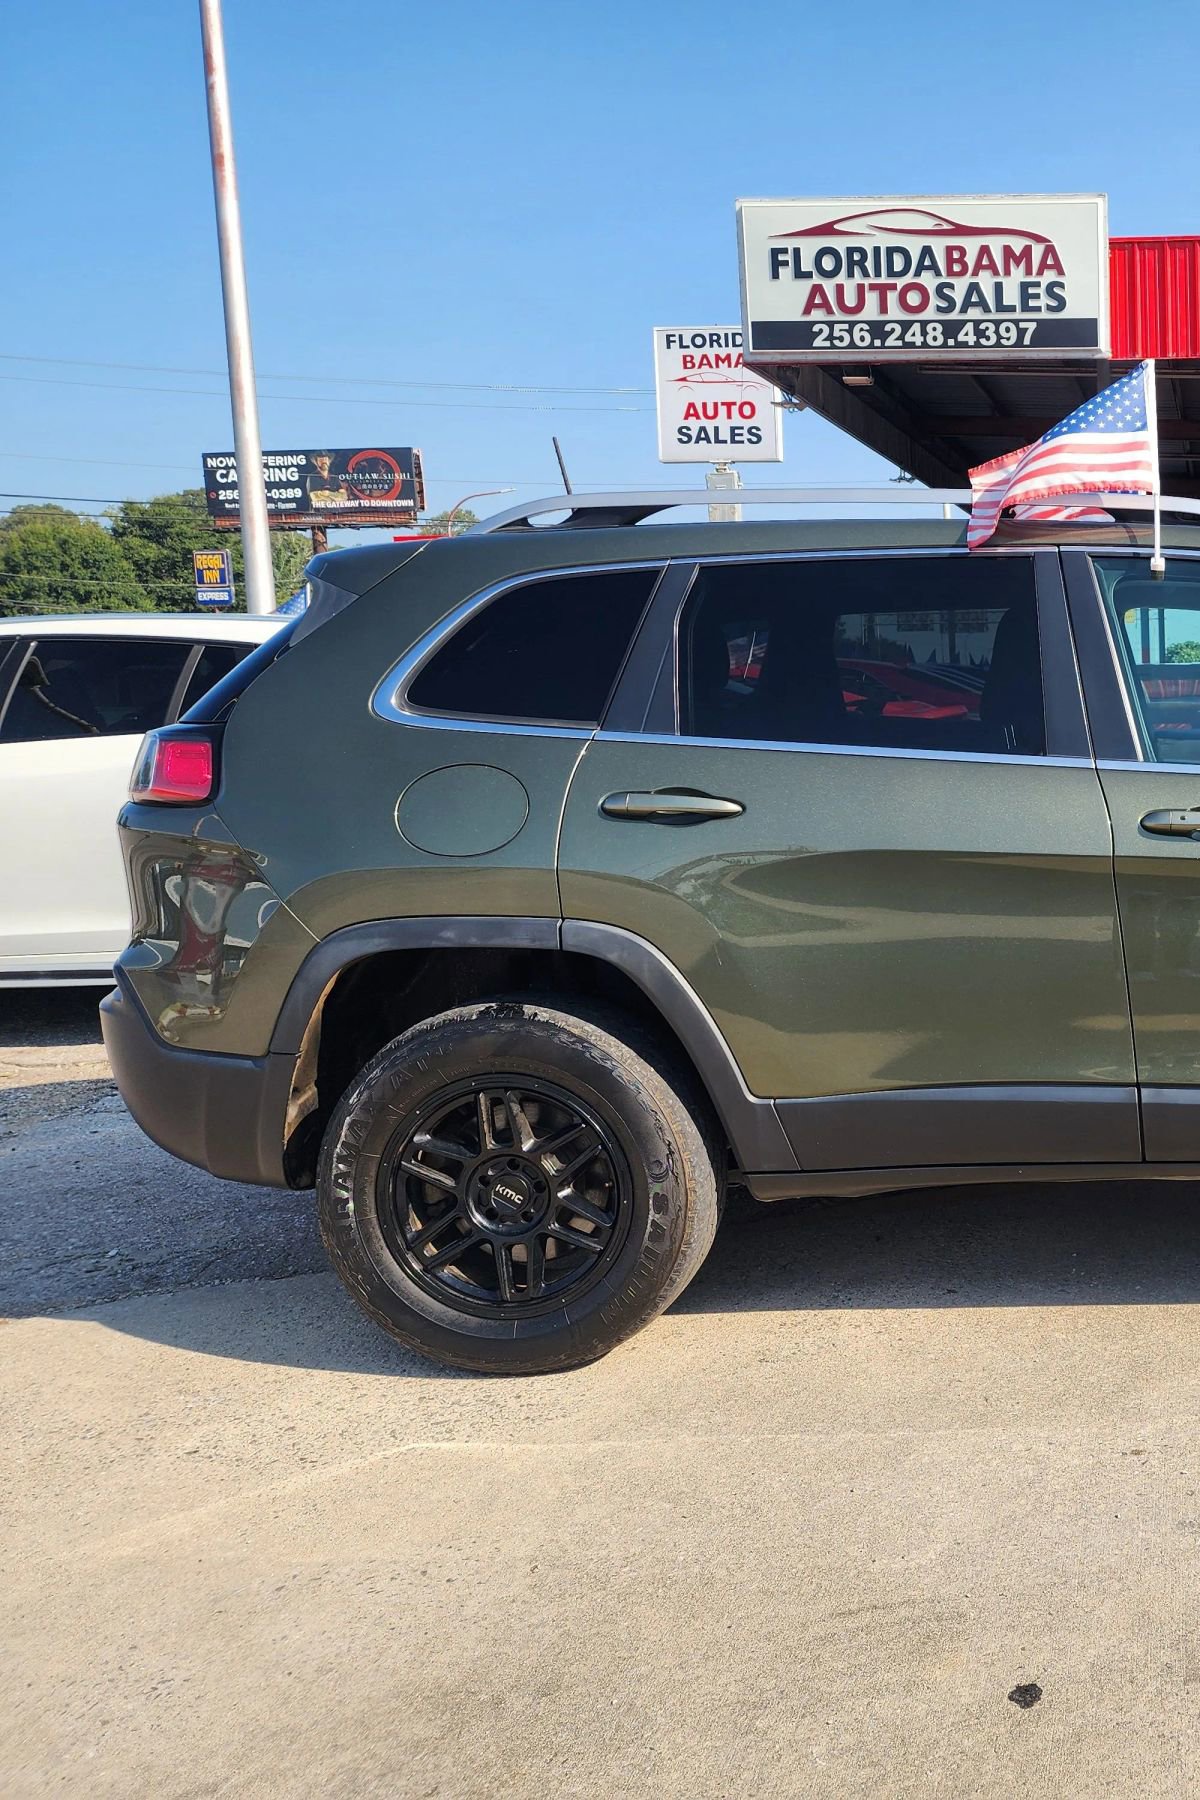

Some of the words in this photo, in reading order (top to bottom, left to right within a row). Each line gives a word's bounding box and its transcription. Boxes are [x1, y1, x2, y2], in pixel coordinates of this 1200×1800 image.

[769, 244, 1066, 280] FLORIDABAMA
[801, 281, 1067, 316] AUTOSALES
[665, 332, 743, 349] FLORID
[811, 321, 1038, 347] 256.248.4397
[682, 352, 744, 370] BAMA
[683, 400, 757, 420] AUTO
[676, 425, 763, 444] SALES
[206, 456, 237, 468] NOW
[262, 454, 307, 466] FERING
[215, 466, 299, 483] CARING
[338, 472, 379, 481] OUTLAW
[383, 472, 411, 480] SUSHI
[326, 500, 360, 508] GATEWAY
[370, 499, 414, 507] DOWNTOWN
[195, 554, 225, 570] REGAL
[203, 569, 221, 584] INN
[197, 591, 229, 601] EXPRESS
